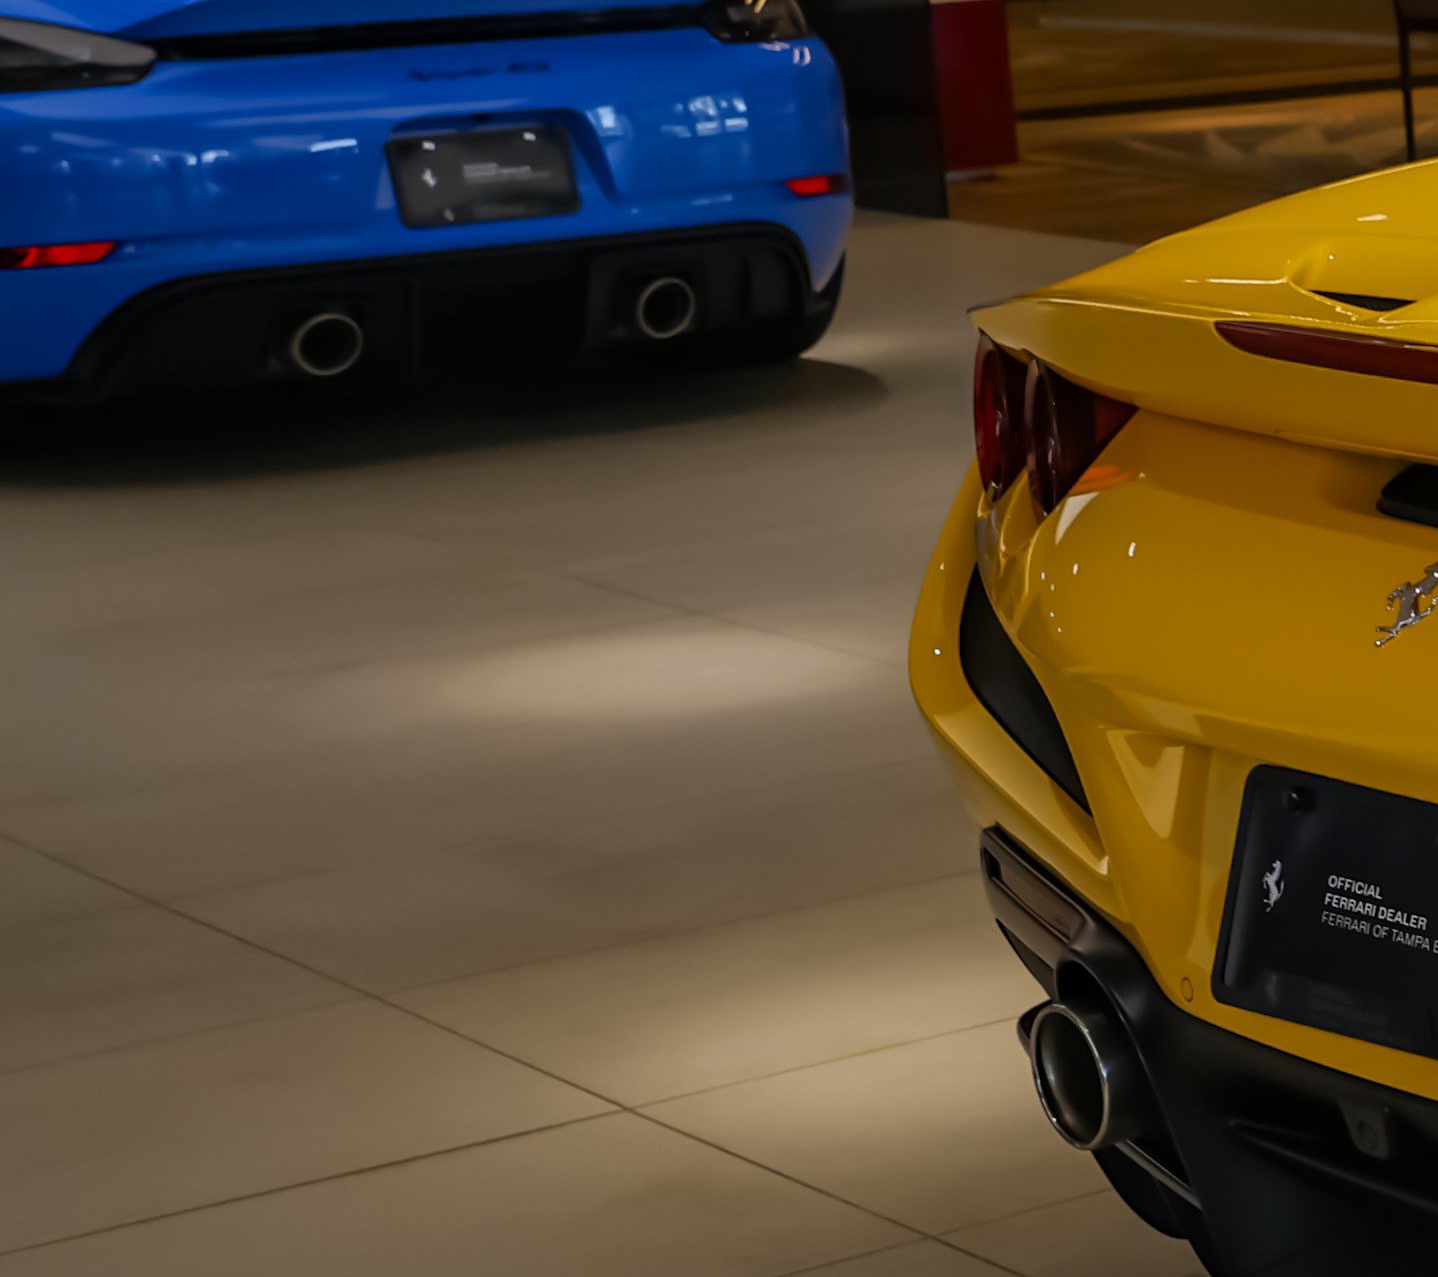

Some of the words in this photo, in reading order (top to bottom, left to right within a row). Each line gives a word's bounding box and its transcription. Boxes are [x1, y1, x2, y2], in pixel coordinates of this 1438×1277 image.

[1328, 875, 1383, 899] OFFICIAL
[1325, 893, 1376, 917] FERRARI
[1378, 907, 1427, 930] DEALER
[1322, 911, 1370, 935] FERRARI
[1372, 924, 1390, 939] OF
[1391, 928, 1430, 951] TAMPA
